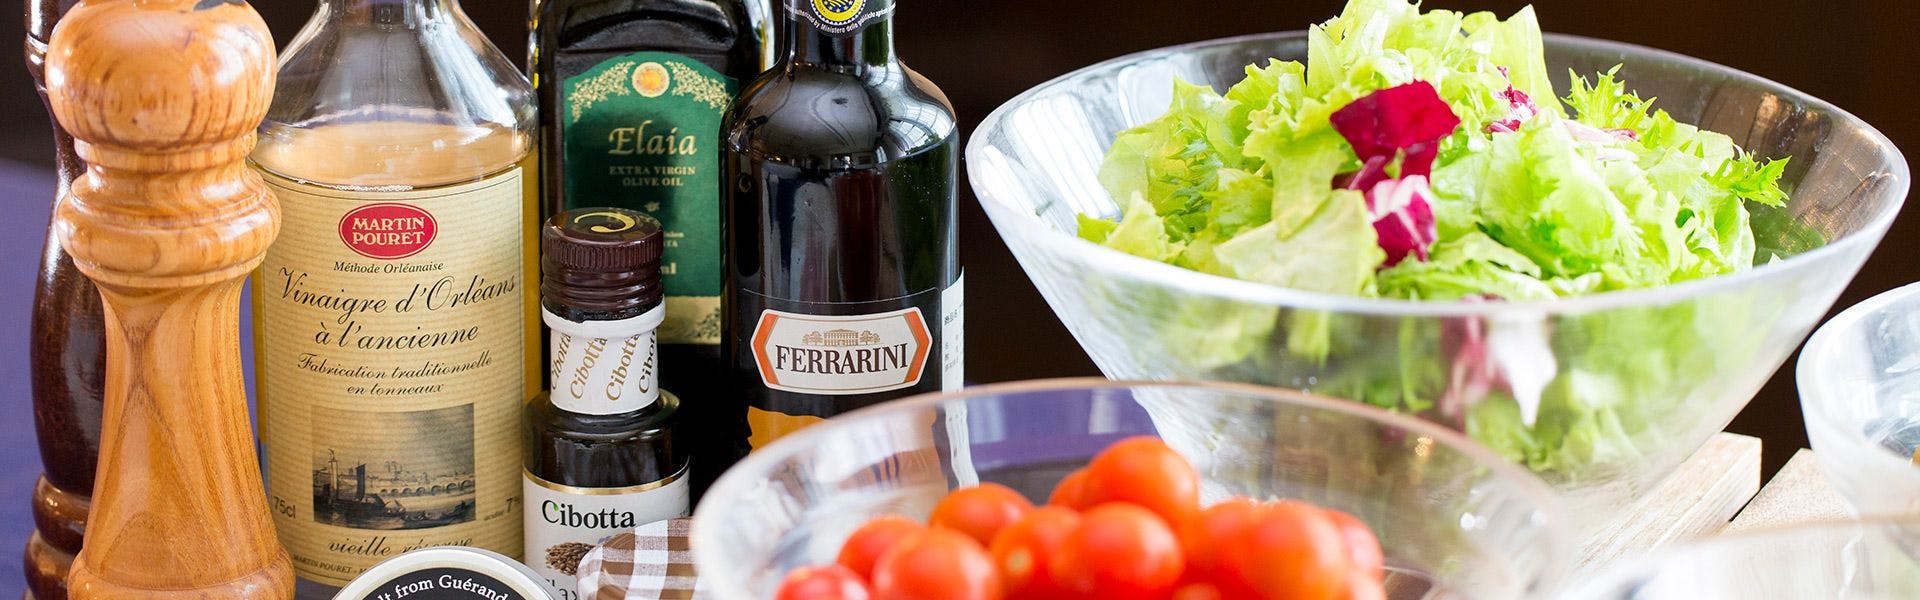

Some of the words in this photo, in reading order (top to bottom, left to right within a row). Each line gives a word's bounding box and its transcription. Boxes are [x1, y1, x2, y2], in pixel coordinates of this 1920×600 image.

[820, 24, 845, 34] Ministero
[608, 120, 698, 156] Elaia
[609, 166, 650, 176] EXTRA
[655, 166, 696, 175] VIRGIN
[622, 177, 660, 187] OLIVE
[661, 177, 684, 187] OIL
[352, 216, 426, 231] MARTIN
[352, 231, 426, 246] POURET
[334, 261, 380, 274] Méthode
[384, 261, 444, 274] Orléanaise
[278, 266, 387, 324] Vinaigre
[396, 274, 516, 313] d'Orléans
[315, 321, 333, 345] à
[339, 320, 479, 350] l'ancienne
[297, 352, 388, 380] Fabrication
[392, 350, 493, 379] traditionnelle
[570, 337, 608, 399] Cibotta
[775, 342, 909, 375] FERRARINI
[347, 384, 366, 395] en
[369, 383, 445, 396] tonneaux
[274, 496, 296, 519] 75cl
[541, 499, 637, 529] Cibotta
[329, 536, 392, 556] vieille
[293, 554, 318, 567] MARTIN
[320, 561, 352, 574] POURET
[395, 578, 434, 598] from
